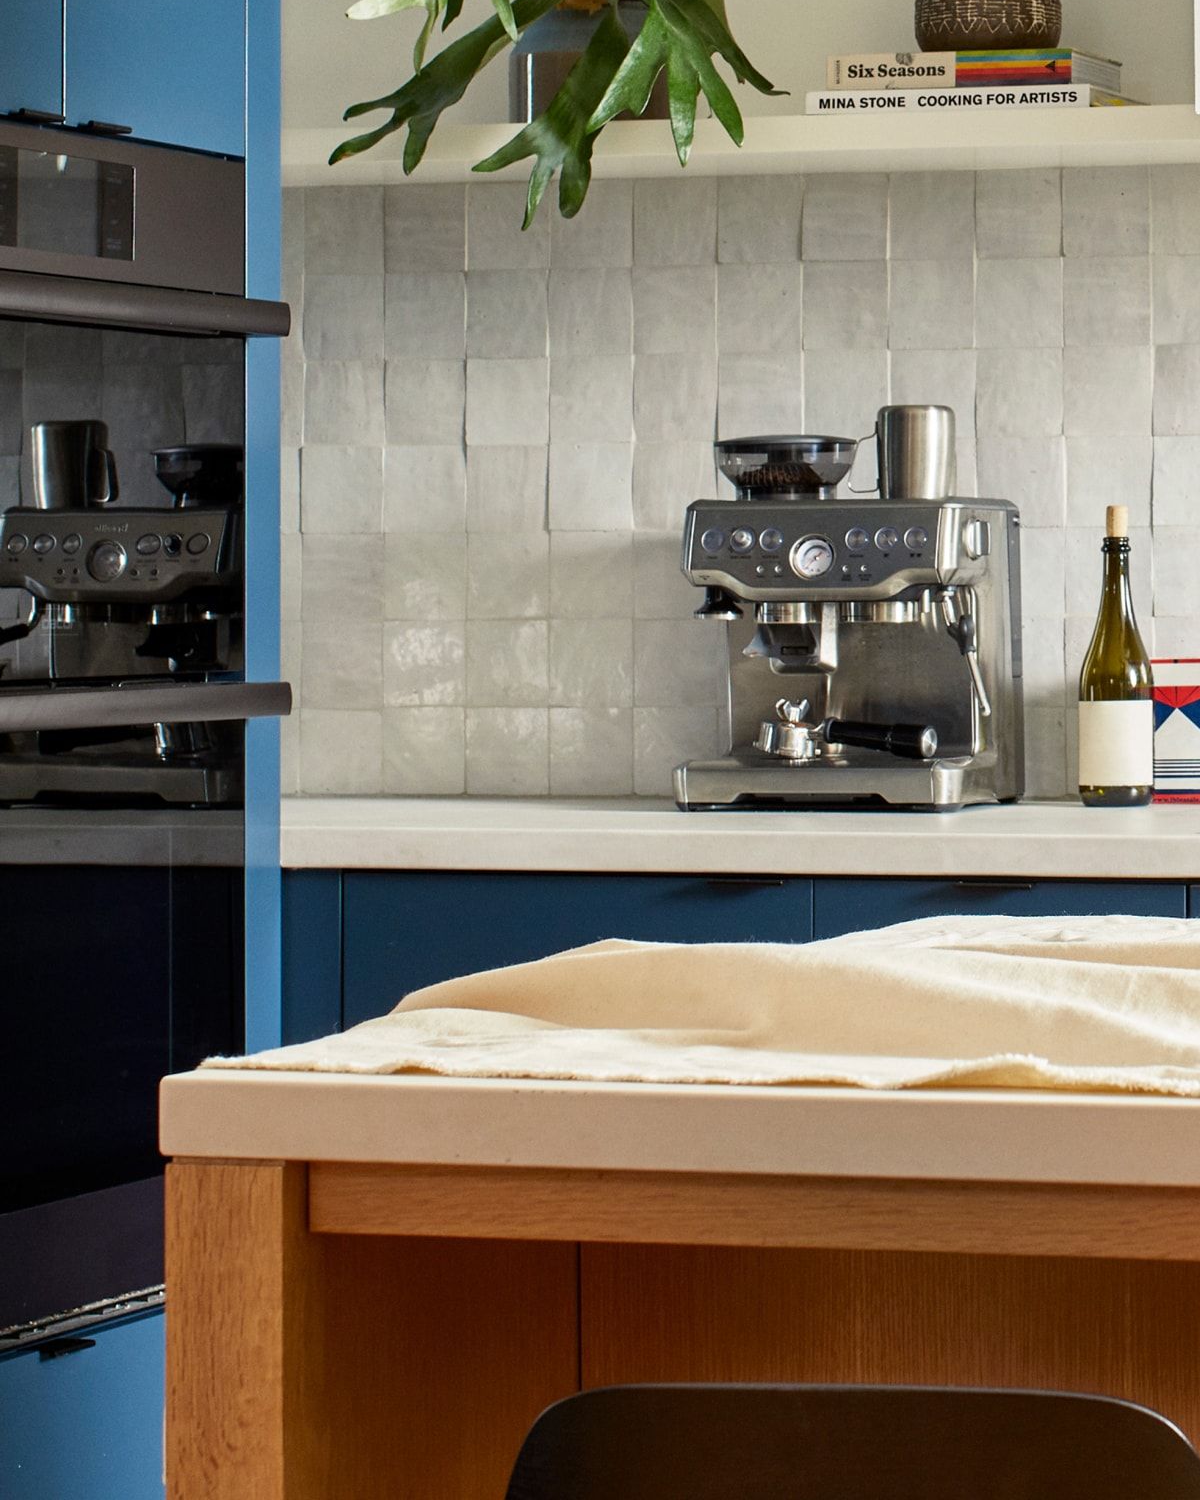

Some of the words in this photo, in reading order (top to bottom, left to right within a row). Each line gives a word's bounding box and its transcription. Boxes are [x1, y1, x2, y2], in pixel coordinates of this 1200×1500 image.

[847, 64, 875, 78] Six
[877, 64, 946, 77] Seasons
[818, 98, 856, 109] MINA
[860, 96, 906, 108] STONE
[917, 94, 982, 107] COOKING
[986, 93, 1016, 105] FOR
[1019, 91, 1078, 104] ARTISTS
